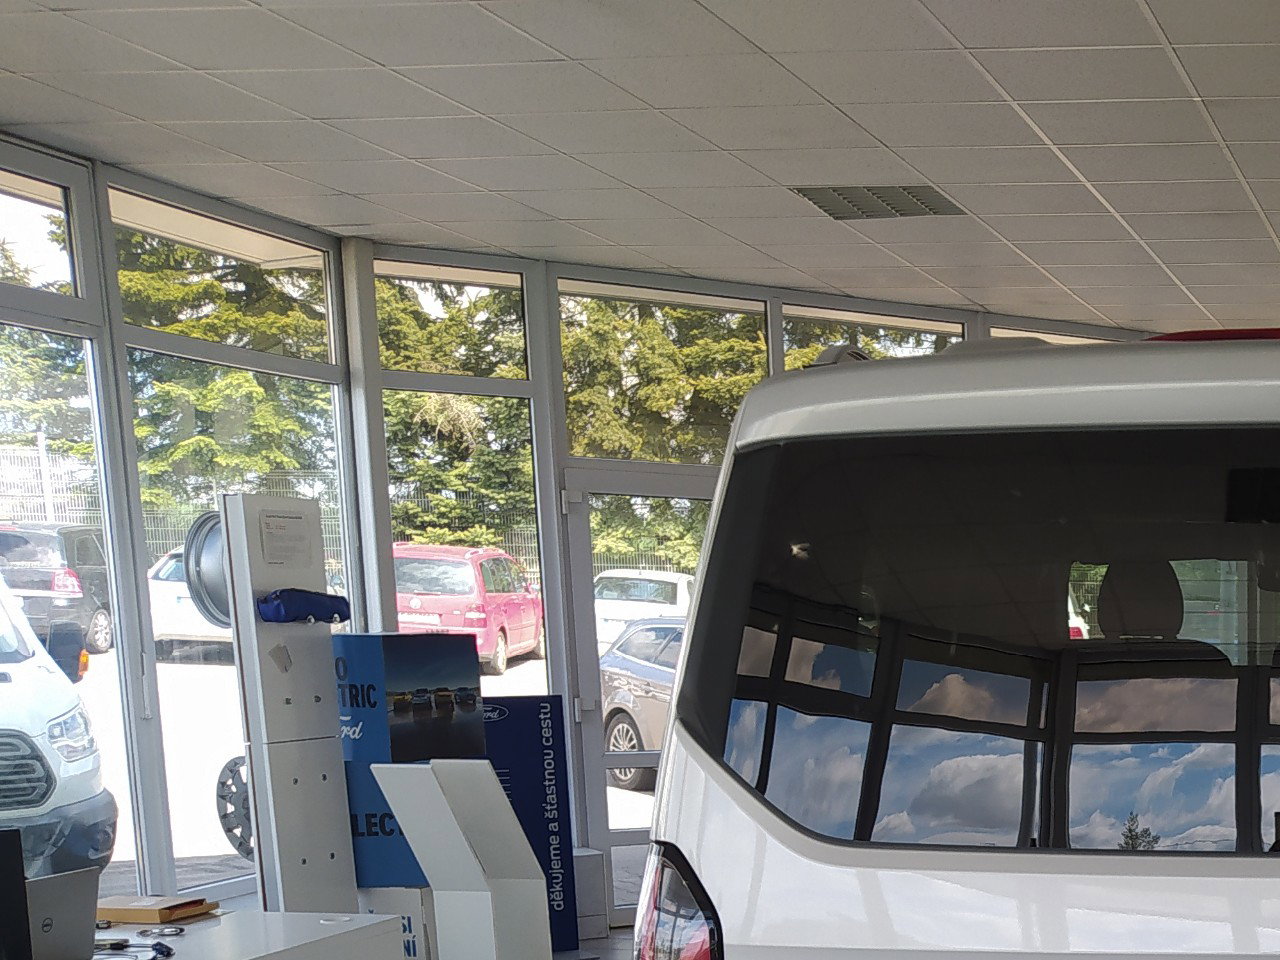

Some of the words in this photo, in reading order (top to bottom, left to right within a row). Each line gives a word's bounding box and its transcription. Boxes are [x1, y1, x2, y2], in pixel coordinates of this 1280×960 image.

[538, 702, 554, 746] cestu
[542, 749, 558, 819] šťastnou
[548, 821, 559, 832] a
[549, 835, 565, 911] děkujeme
